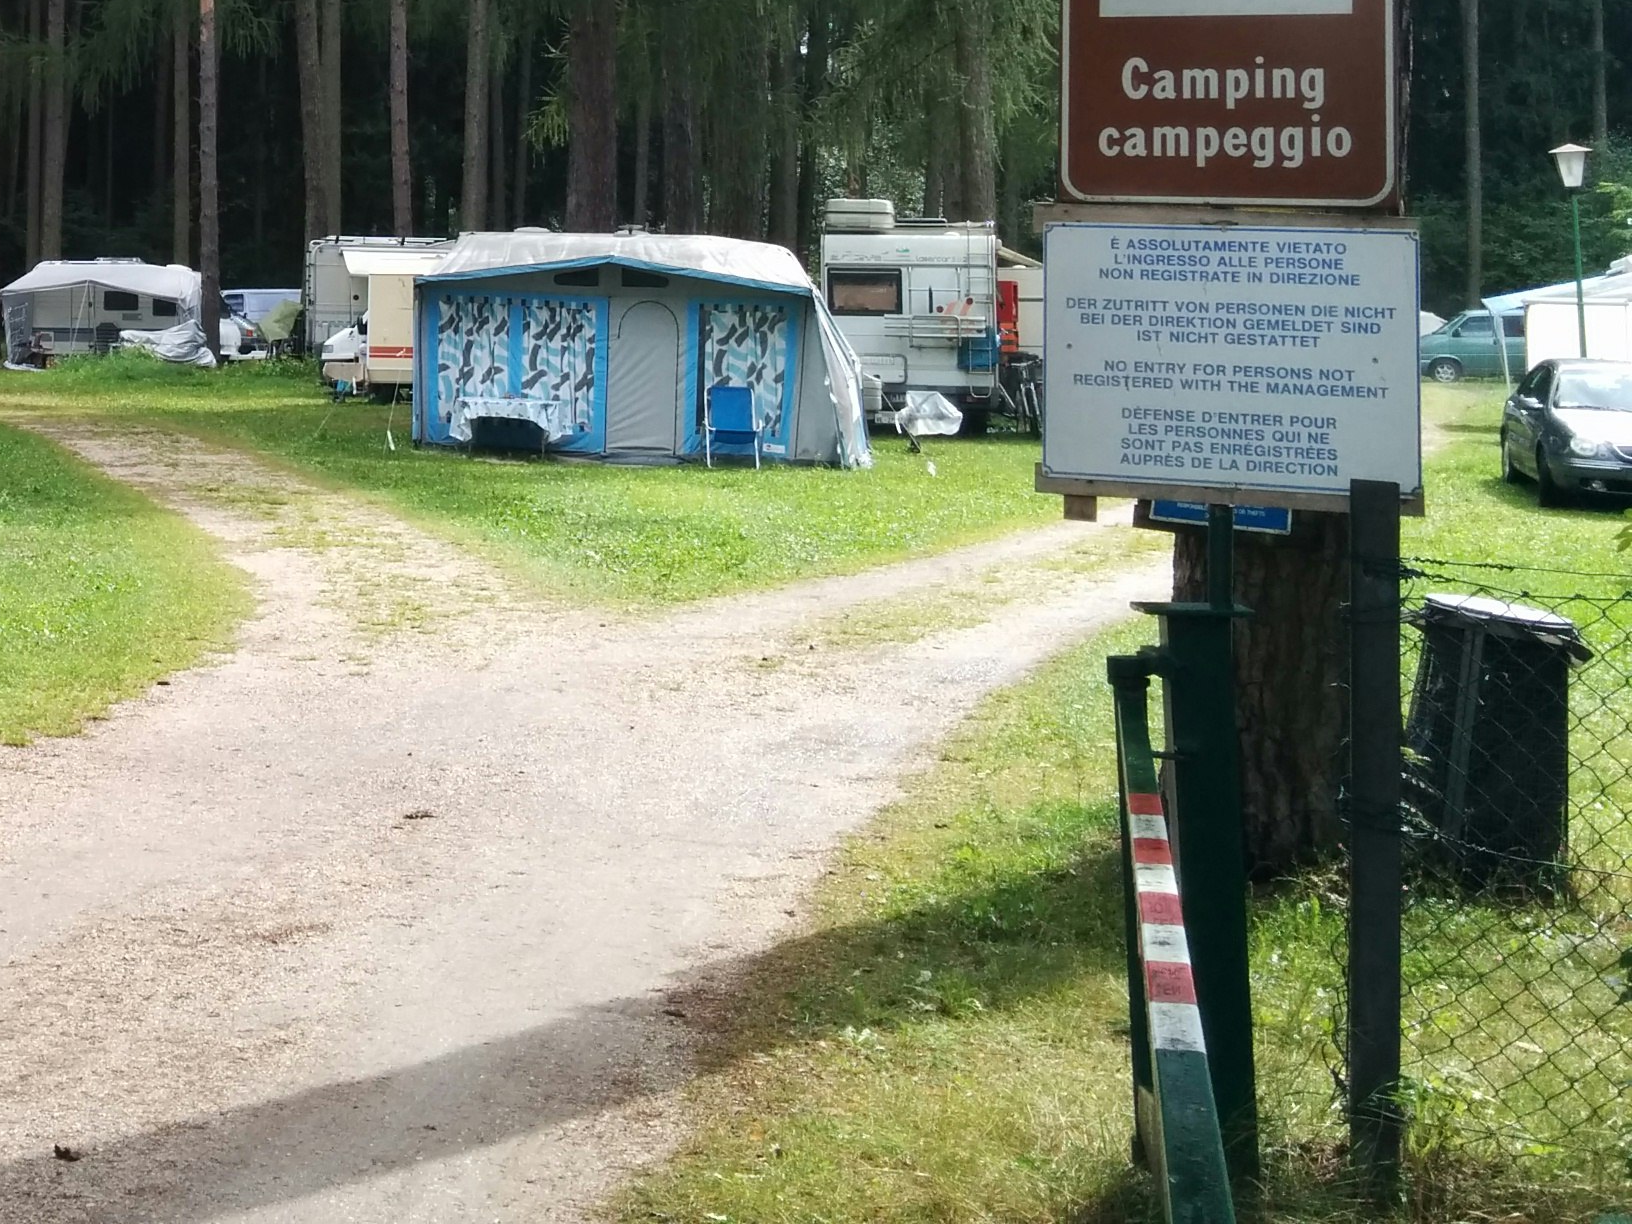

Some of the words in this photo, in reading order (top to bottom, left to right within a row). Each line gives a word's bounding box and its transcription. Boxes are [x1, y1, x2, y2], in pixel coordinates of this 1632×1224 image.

[1121, 56, 1325, 109] Camping
[1098, 114, 1352, 168] campeggio
[1126, 239, 1269, 252] ASSOLUTAMENTE
[1276, 242, 1346, 254] VIETATO
[1115, 254, 1210, 267] L'INGRESSO
[1217, 256, 1257, 268] ALLE
[1264, 257, 1343, 270] PERSONE
[1100, 268, 1133, 280] NON
[1140, 269, 1240, 282] REGISTRATE
[1248, 272, 1262, 282] IN
[1270, 272, 1360, 286] DIREZIONE
[1067, 298, 1097, 309] DER
[1102, 299, 1169, 312] ZUTRITT
[1175, 301, 1209, 313] VON
[1216, 303, 1305, 316] PERSONEN
[1312, 305, 1338, 317] DIE
[1345, 307, 1396, 319] NICHT
[1081, 313, 1104, 324] BEI
[1111, 314, 1142, 326] DER
[1149, 315, 1236, 329] DIREKTION
[1243, 318, 1334, 332] GEMELDET
[1341, 322, 1381, 334] SIND
[1138, 330, 1162, 341] IST
[1170, 331, 1219, 344] NICHT
[1224, 333, 1320, 348] GESTATTET
[1104, 360, 1127, 372] NO
[1134, 362, 1186, 374] ENTRY
[1193, 364, 1226, 376] FOR
[1233, 366, 1312, 380] PERSONS
[1320, 369, 1354, 381] NOT
[1074, 374, 1173, 390] REGISTERED
[1180, 379, 1220, 391] WITH
[1227, 380, 1259, 393] THE
[1266, 382, 1388, 398] MANAGEMENT
[1122, 407, 1195, 422] DÉFENSE
[1202, 412, 1283, 426] D'ENTRER
[1290, 416, 1336, 429] POUR
[1129, 424, 1158, 435] LES
[1165, 425, 1264, 441] PERSONNES
[1272, 430, 1300, 443] QUI
[1308, 432, 1329, 444] NE
[1122, 438, 1166, 451] SONT
[1172, 441, 1203, 453] PAS
[1192, 457, 1212, 469] DE
[1220, 458, 1239, 470] LA
[1246, 460, 1338, 476] DIRECTION
